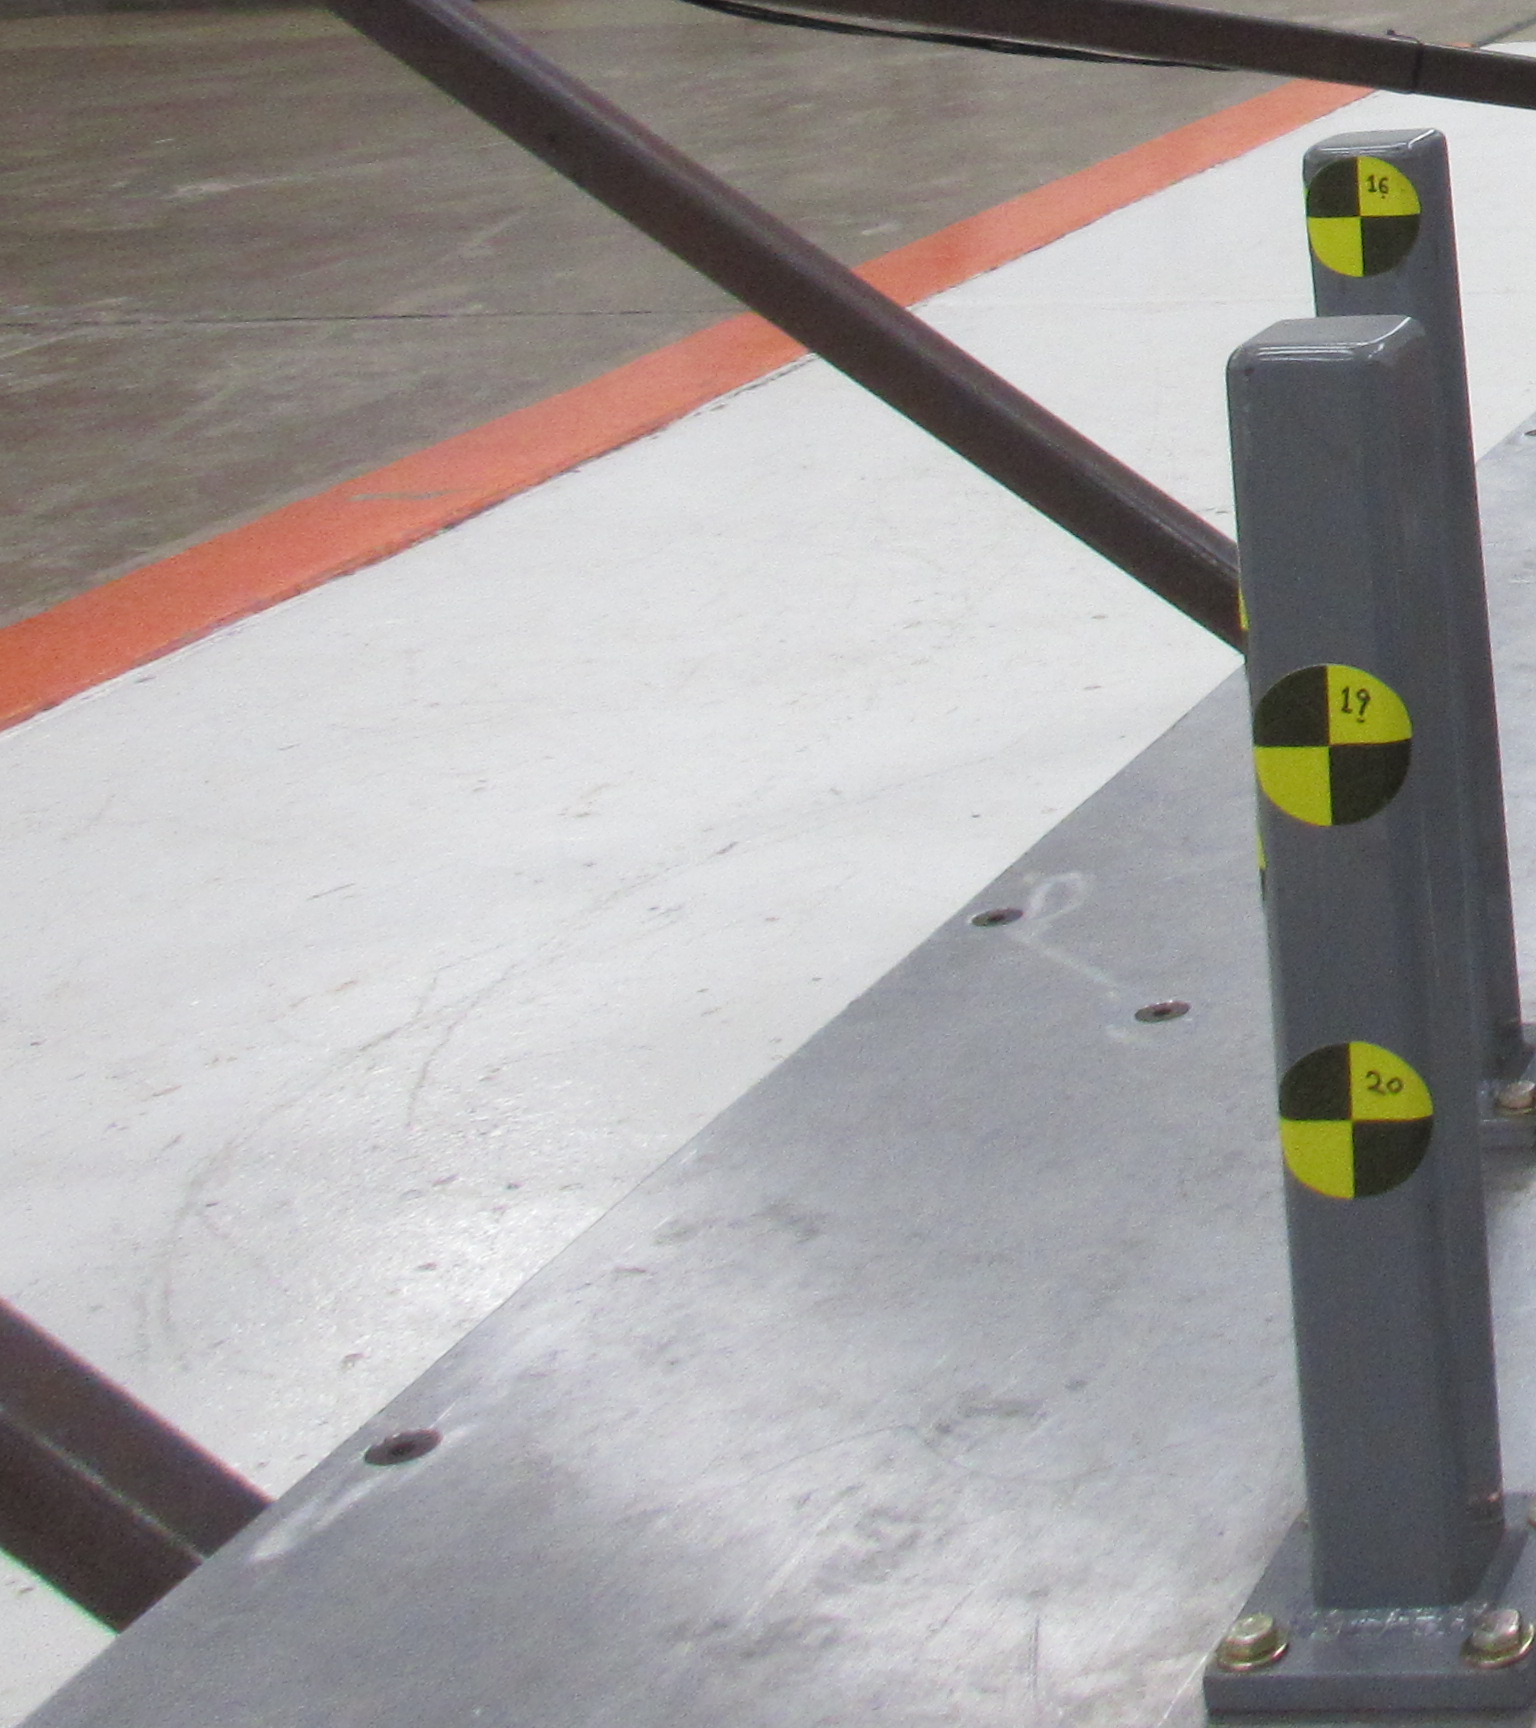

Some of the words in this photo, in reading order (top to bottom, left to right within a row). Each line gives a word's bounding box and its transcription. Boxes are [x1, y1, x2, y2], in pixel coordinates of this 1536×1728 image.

[1366, 174, 1389, 198] 16
[1341, 686, 1371, 722] 19
[1366, 1070, 1403, 1095] 20
